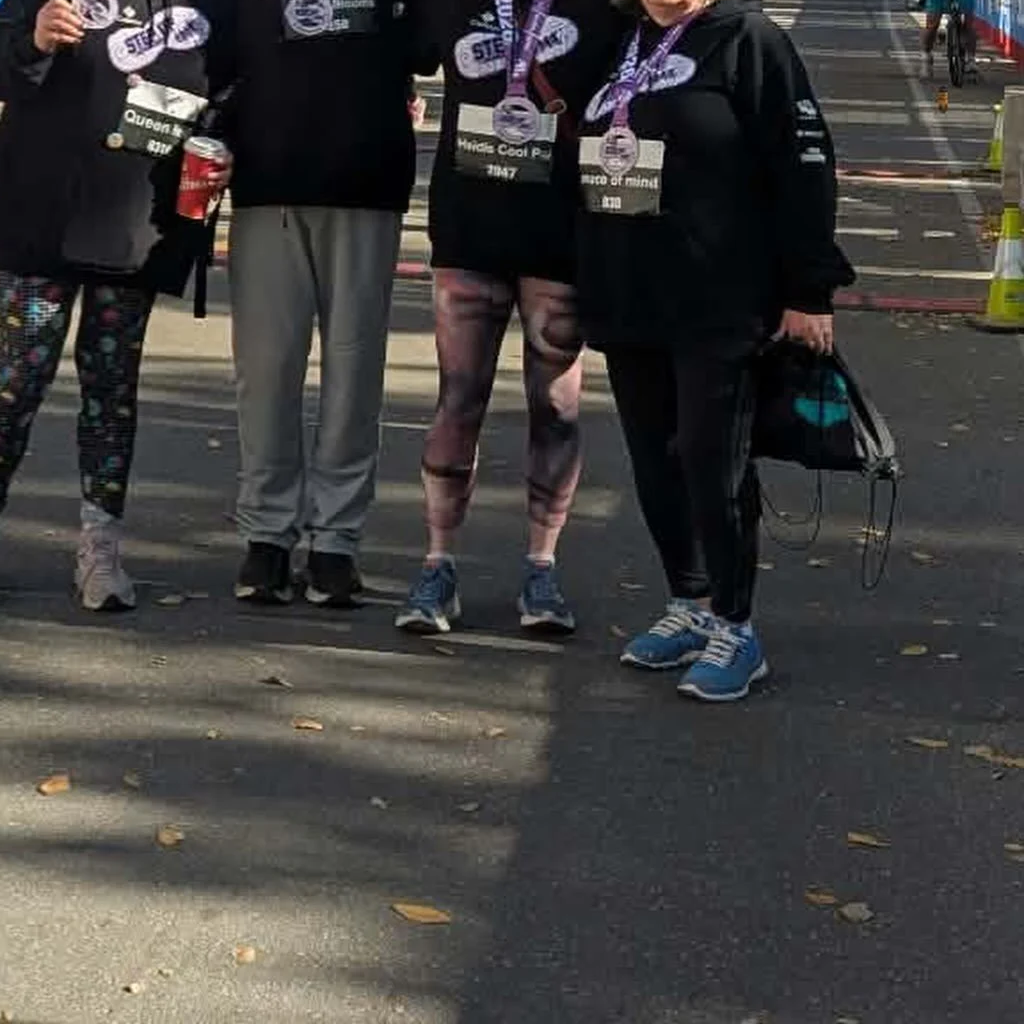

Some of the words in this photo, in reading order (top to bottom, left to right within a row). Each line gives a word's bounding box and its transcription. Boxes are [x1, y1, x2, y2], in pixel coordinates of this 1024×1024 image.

[472, 39, 505, 62] STE
[124, 109, 171, 134] Queen
[498, 143, 528, 157] Cool
